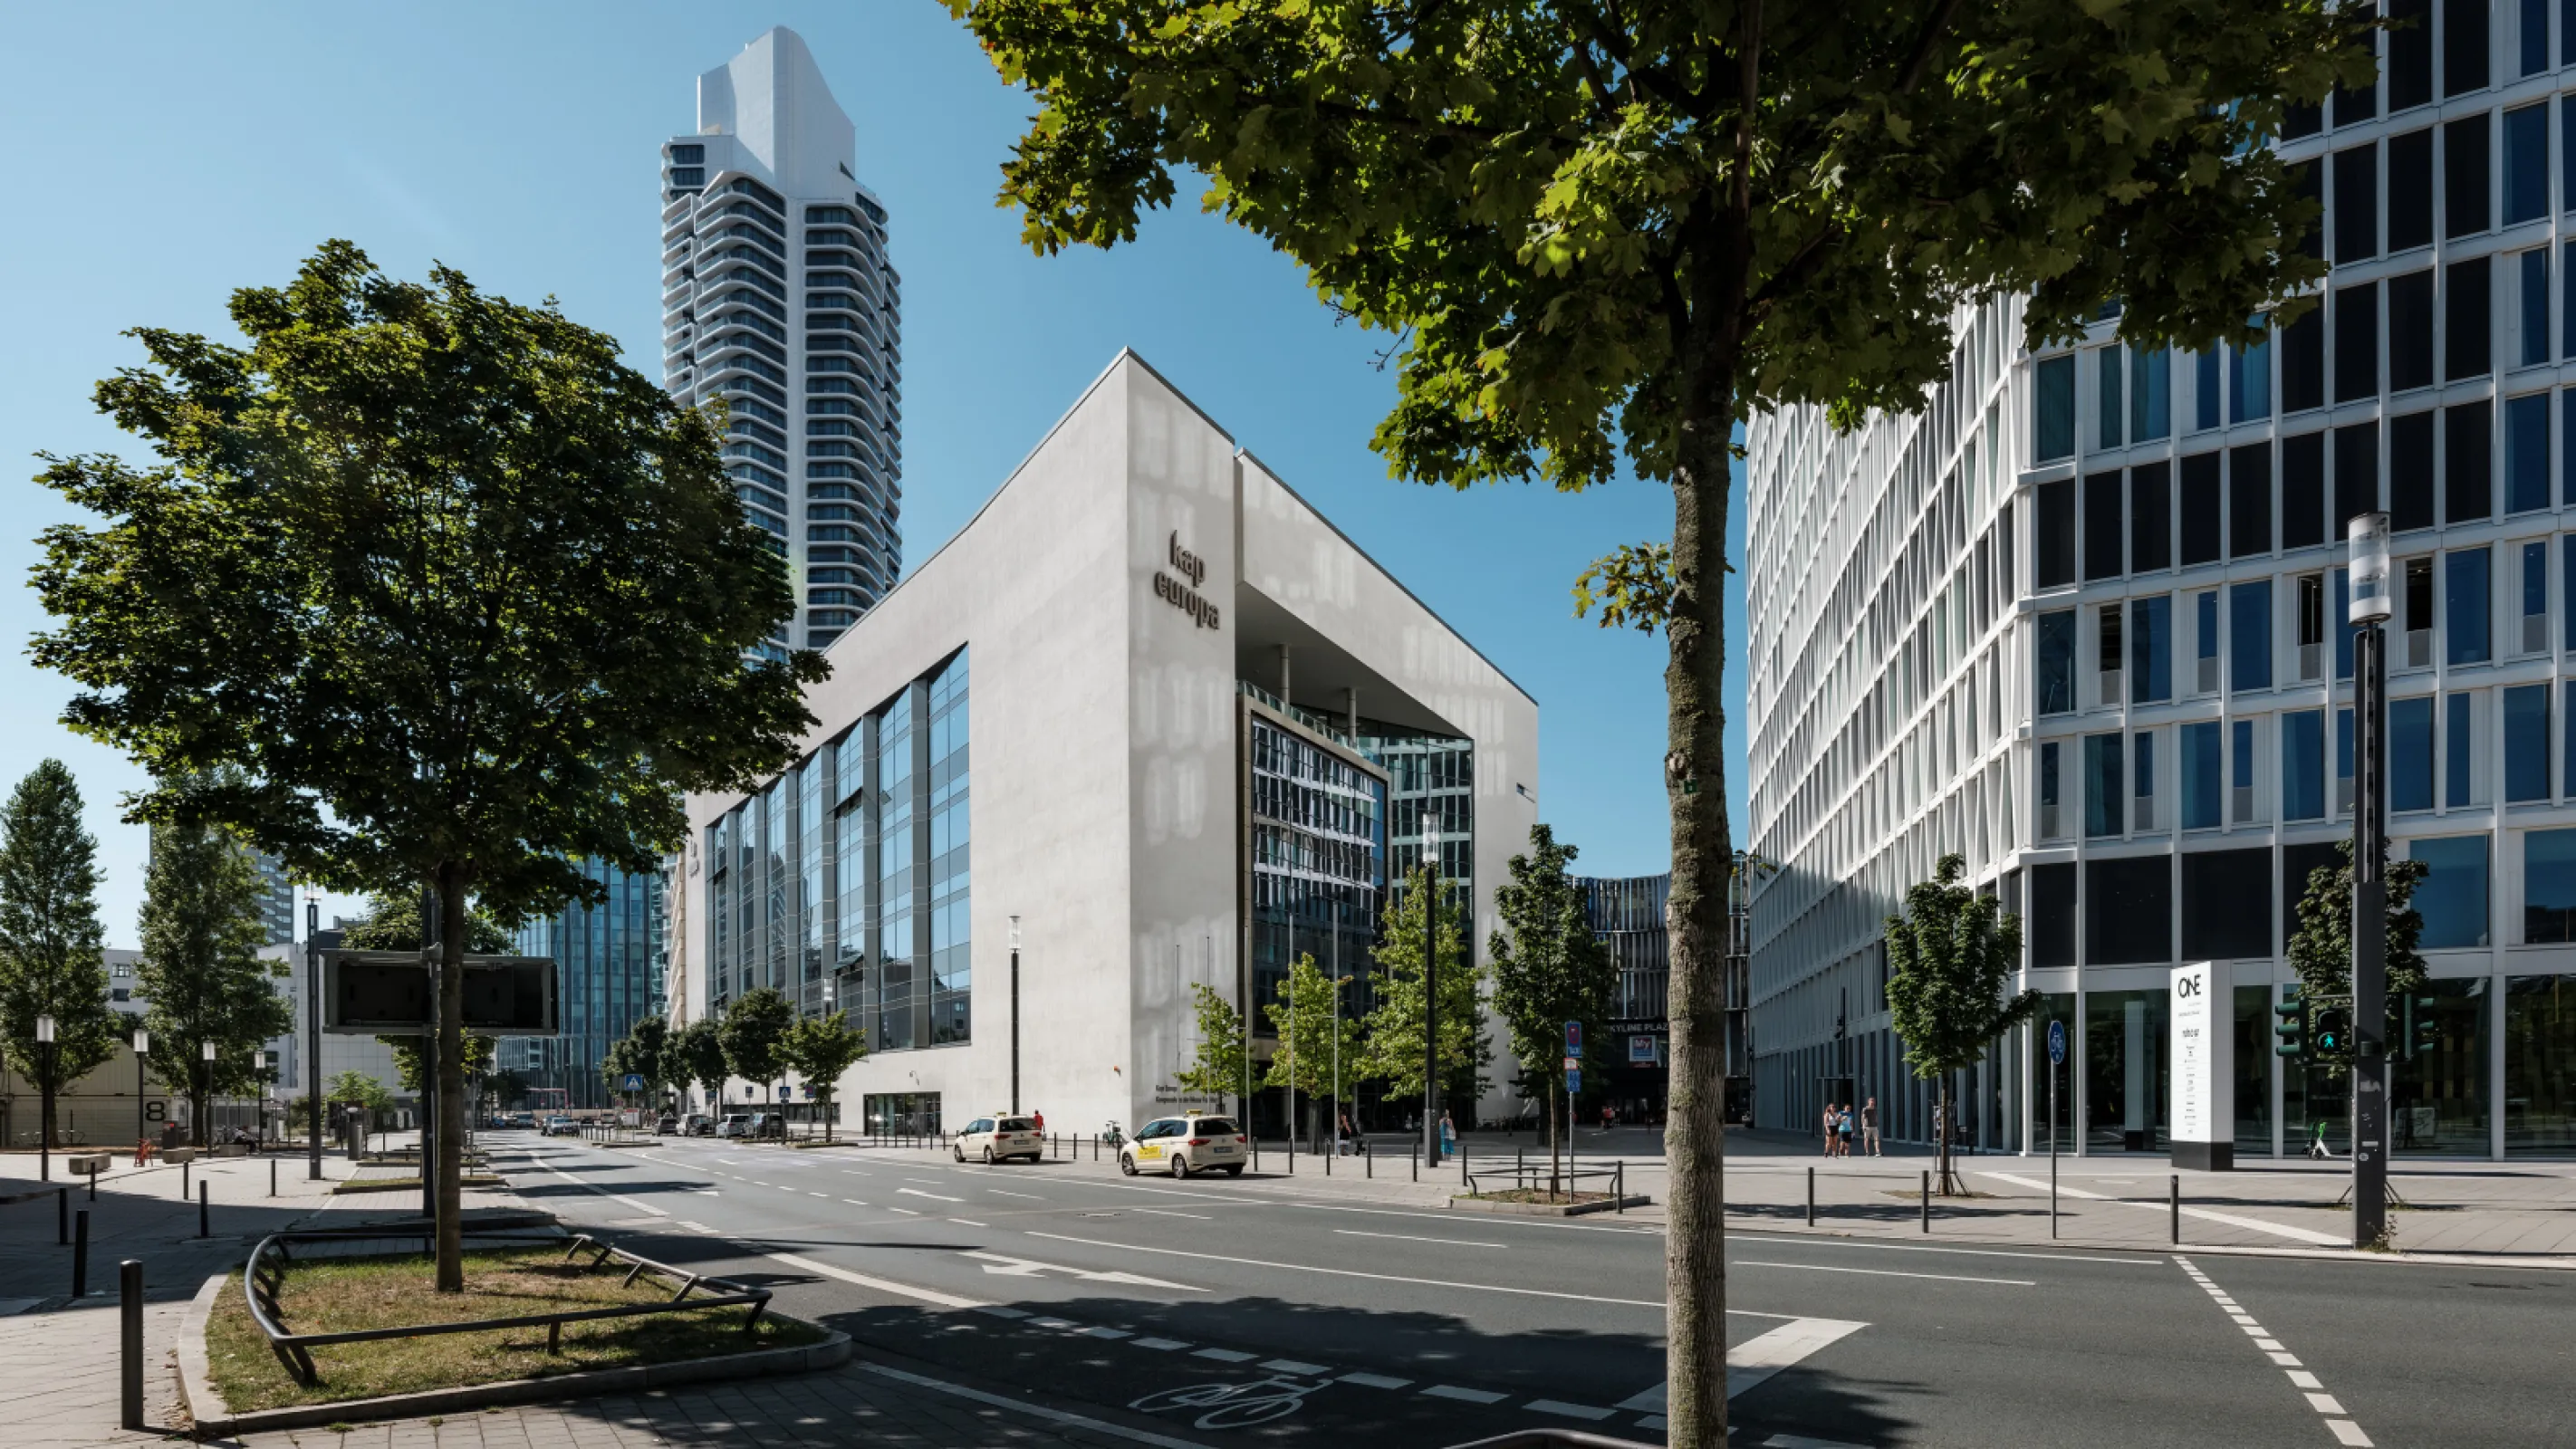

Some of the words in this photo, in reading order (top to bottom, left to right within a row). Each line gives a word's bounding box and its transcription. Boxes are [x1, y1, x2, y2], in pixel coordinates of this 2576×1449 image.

[1169, 529, 1206, 588] kap
[1154, 571, 1220, 629] europa
[2178, 974, 2201, 998] ONE
[1644, 1022, 1669, 1032] PLAZ
[146, 1100, 166, 1121] 8
